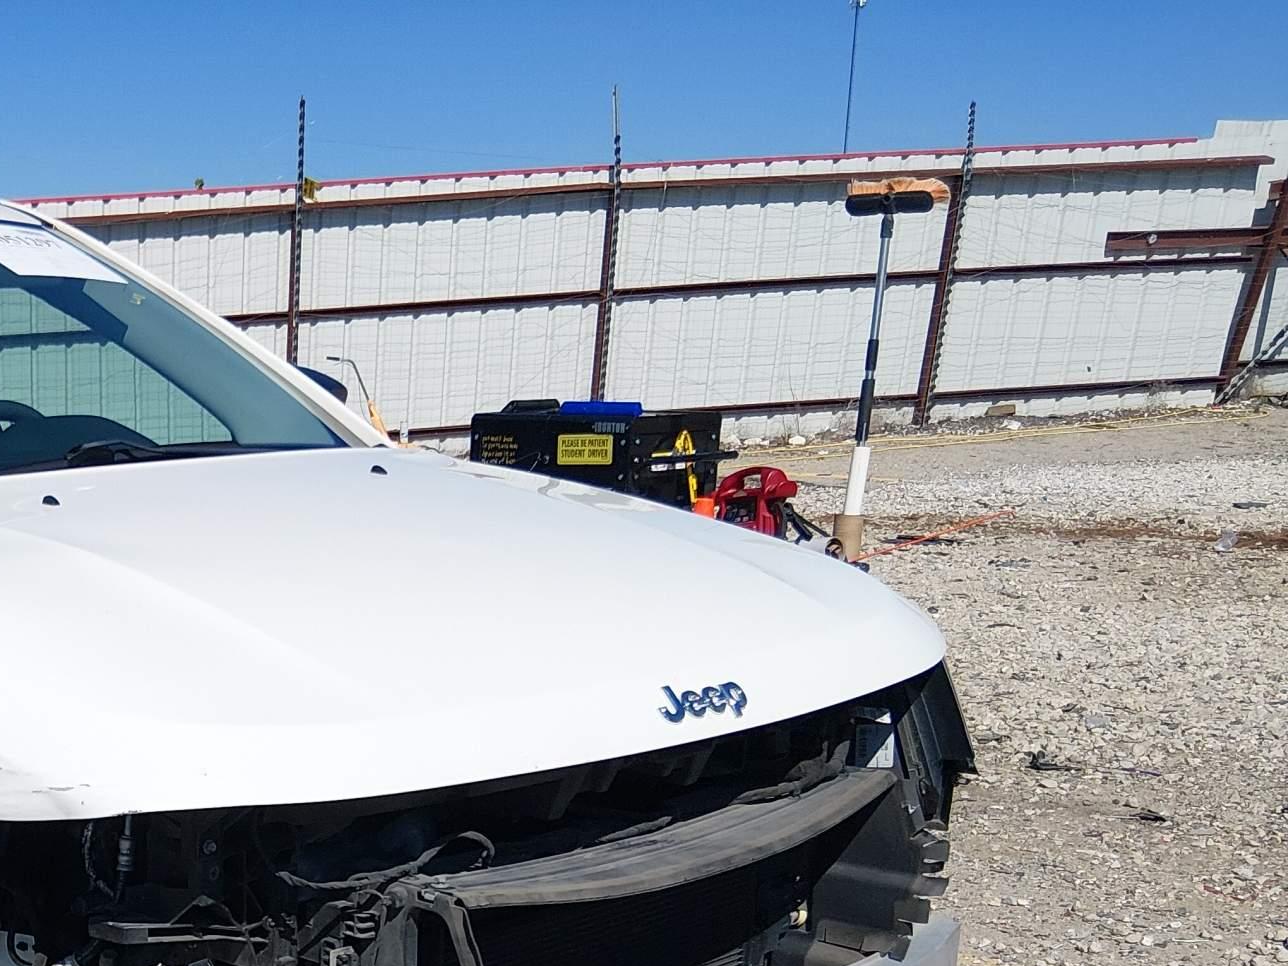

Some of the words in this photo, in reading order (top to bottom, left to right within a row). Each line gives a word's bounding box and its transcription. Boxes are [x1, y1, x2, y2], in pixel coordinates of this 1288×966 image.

[561, 439, 580, 448] PLEASE
[580, 439, 588, 448] BE
[588, 438, 609, 448] PATIENT
[560, 449, 586, 458] STUDENT
[587, 449, 608, 458] DRIVER
[658, 681, 748, 723] Jeep
